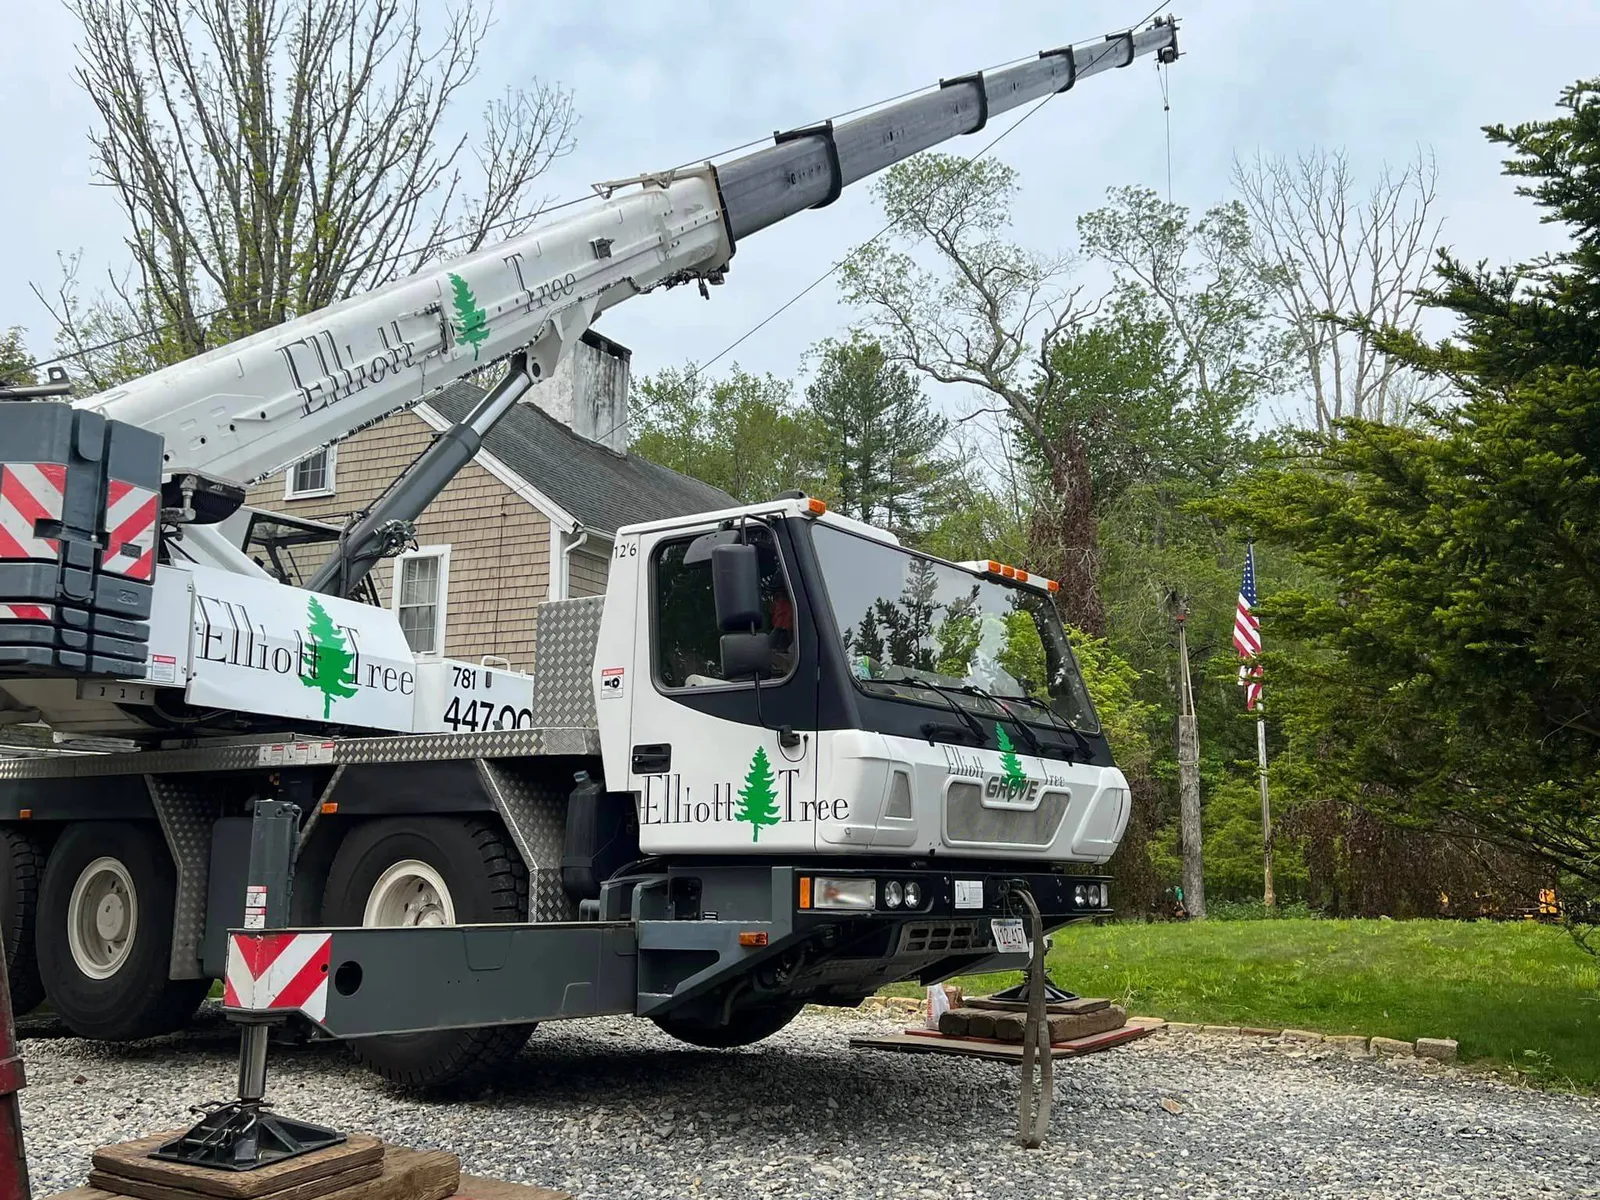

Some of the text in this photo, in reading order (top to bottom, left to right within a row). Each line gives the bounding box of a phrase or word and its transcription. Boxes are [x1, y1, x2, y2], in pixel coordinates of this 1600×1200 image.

[275, 252, 577, 419] Elliott Tree
[195, 594, 414, 695] Elliott Tree
[453, 666, 476, 690] 781
[640, 768, 850, 825] Elliott Tree
[986, 776, 1039, 802] GROVE
